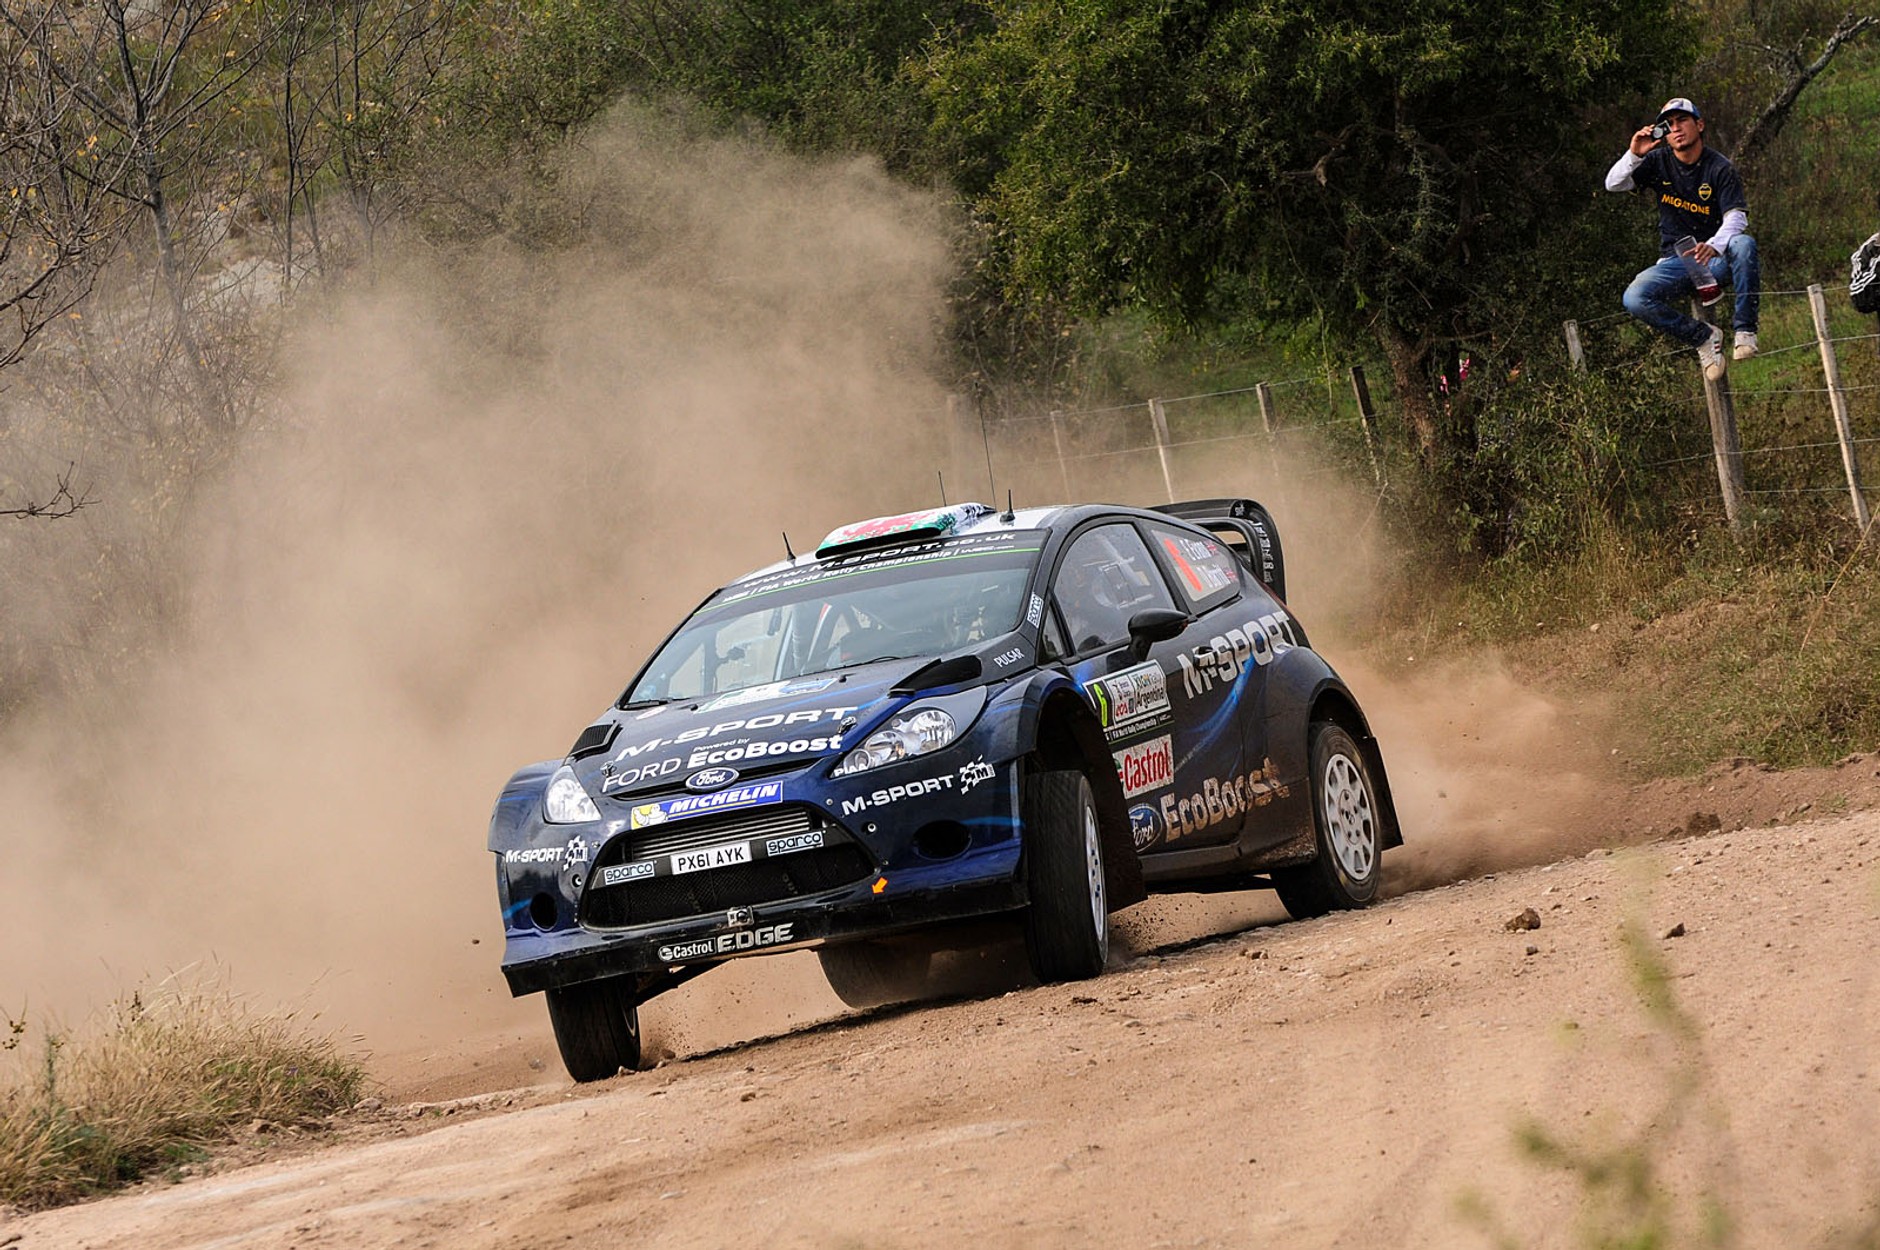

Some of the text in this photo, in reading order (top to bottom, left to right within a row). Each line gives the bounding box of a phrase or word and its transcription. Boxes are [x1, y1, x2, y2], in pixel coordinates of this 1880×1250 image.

[783, 573, 820, 588] World
[823, 563, 857, 578] Rally
[858, 549, 952, 571] Championship
[993, 647, 1025, 668] PULSAR
[1177, 610, 1298, 700] M-SPORT
[615, 706, 858, 763] M-SPORT
[693, 737, 750, 752] Powered by
[602, 734, 844, 793] FORD EcoBoost
[833, 763, 869, 777] PIAA
[1124, 741, 1171, 792] Castrol
[696, 768, 726, 788] Ford
[668, 783, 779, 814] MICHELIN
[841, 775, 954, 815] M-SPORT
[506, 847, 564, 863] M-SPORT
[768, 833, 821, 852] sparco
[716, 846, 745, 868] AYK
[605, 862, 654, 881] sparco
[673, 922, 795, 959] Castrol EDGE
